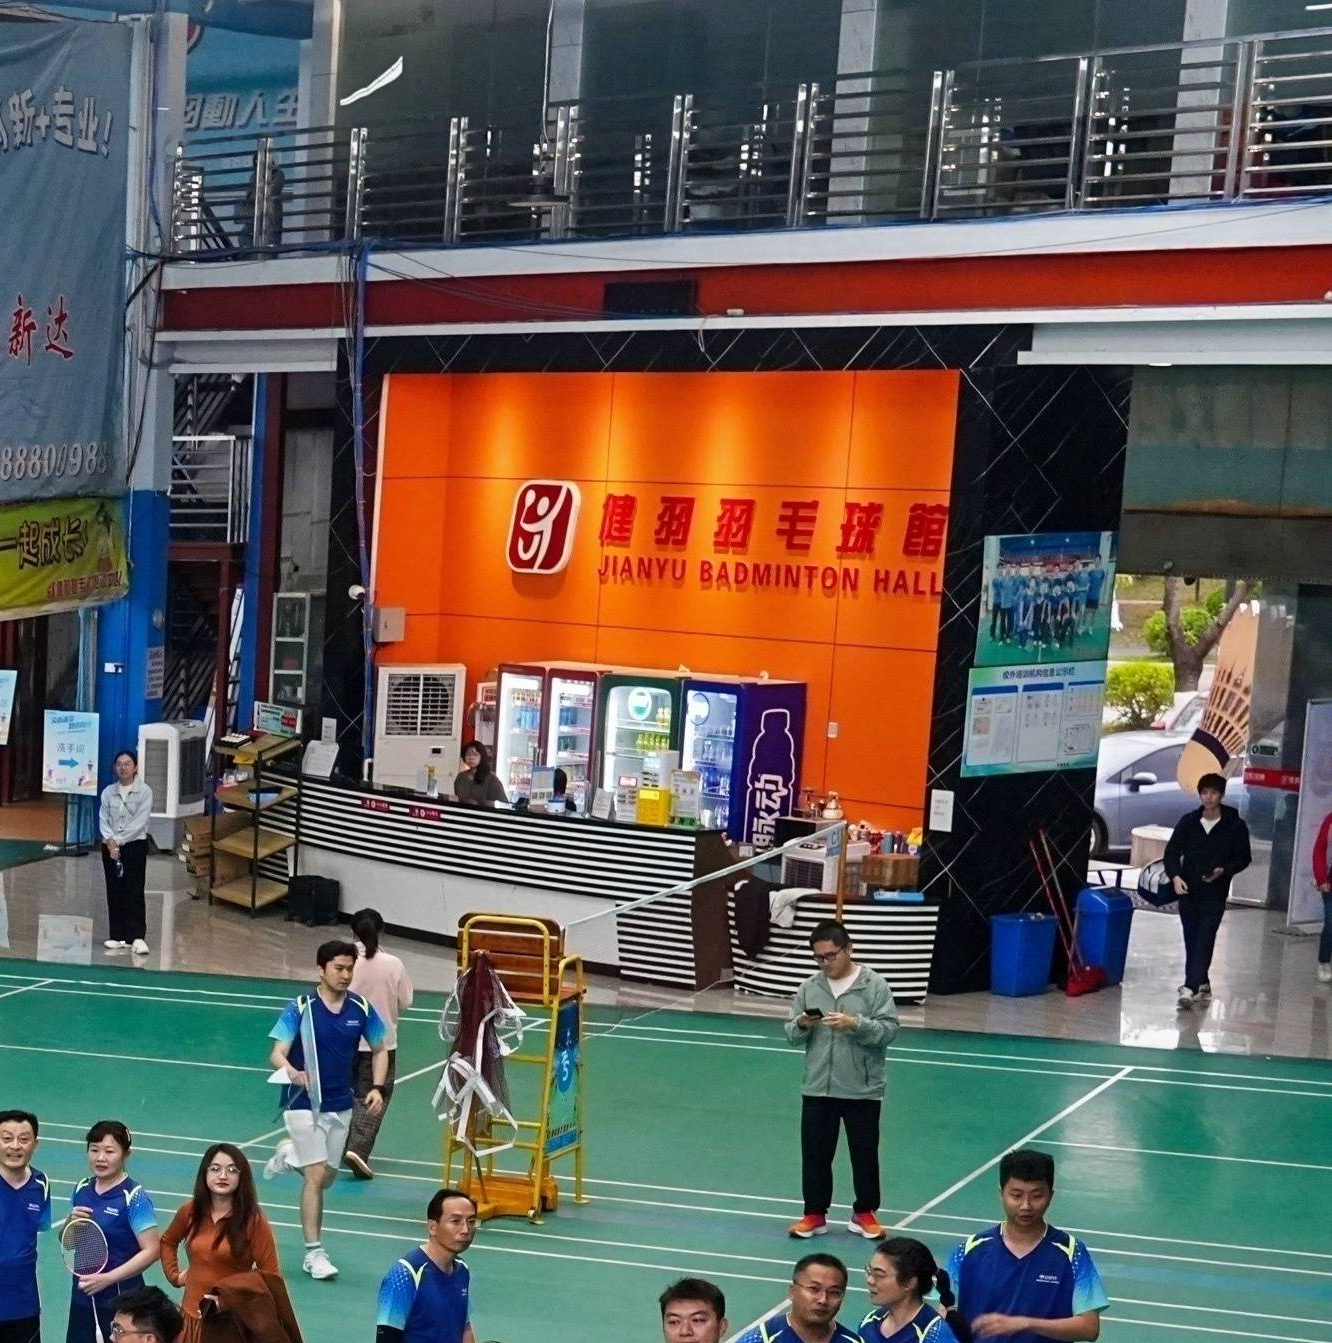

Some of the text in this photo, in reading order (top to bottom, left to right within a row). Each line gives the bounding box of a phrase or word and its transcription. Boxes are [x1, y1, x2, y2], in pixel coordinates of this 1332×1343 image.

[7, 295, 75, 367] 新达
[599, 493, 949, 558] 健羽羽毛球館
[598, 555, 943, 597] JIANYU BADMINTON HALL
